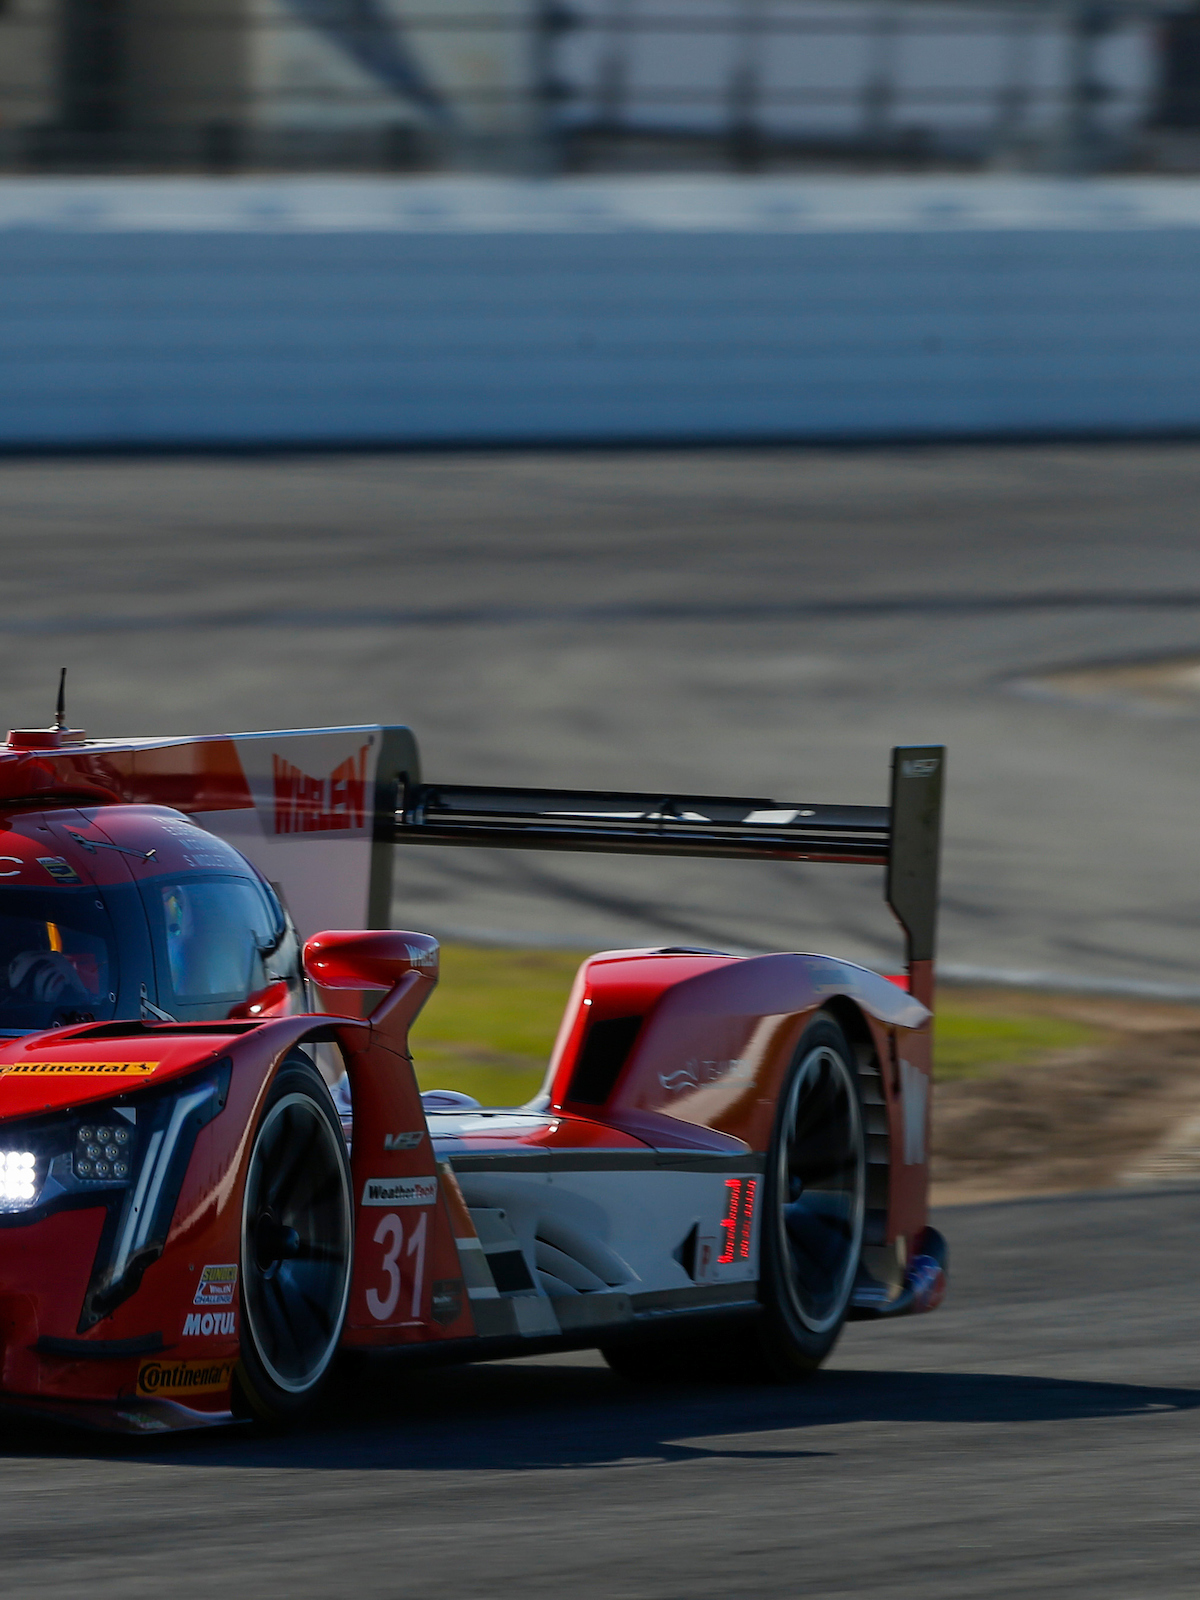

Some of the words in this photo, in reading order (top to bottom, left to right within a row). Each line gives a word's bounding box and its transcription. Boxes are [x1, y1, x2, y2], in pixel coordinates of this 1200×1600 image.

[272, 744, 370, 834] WHELEN
[366, 1211, 428, 1320] 31
[182, 1312, 235, 1336] MOTUL
[138, 1362, 223, 1393] Continental
